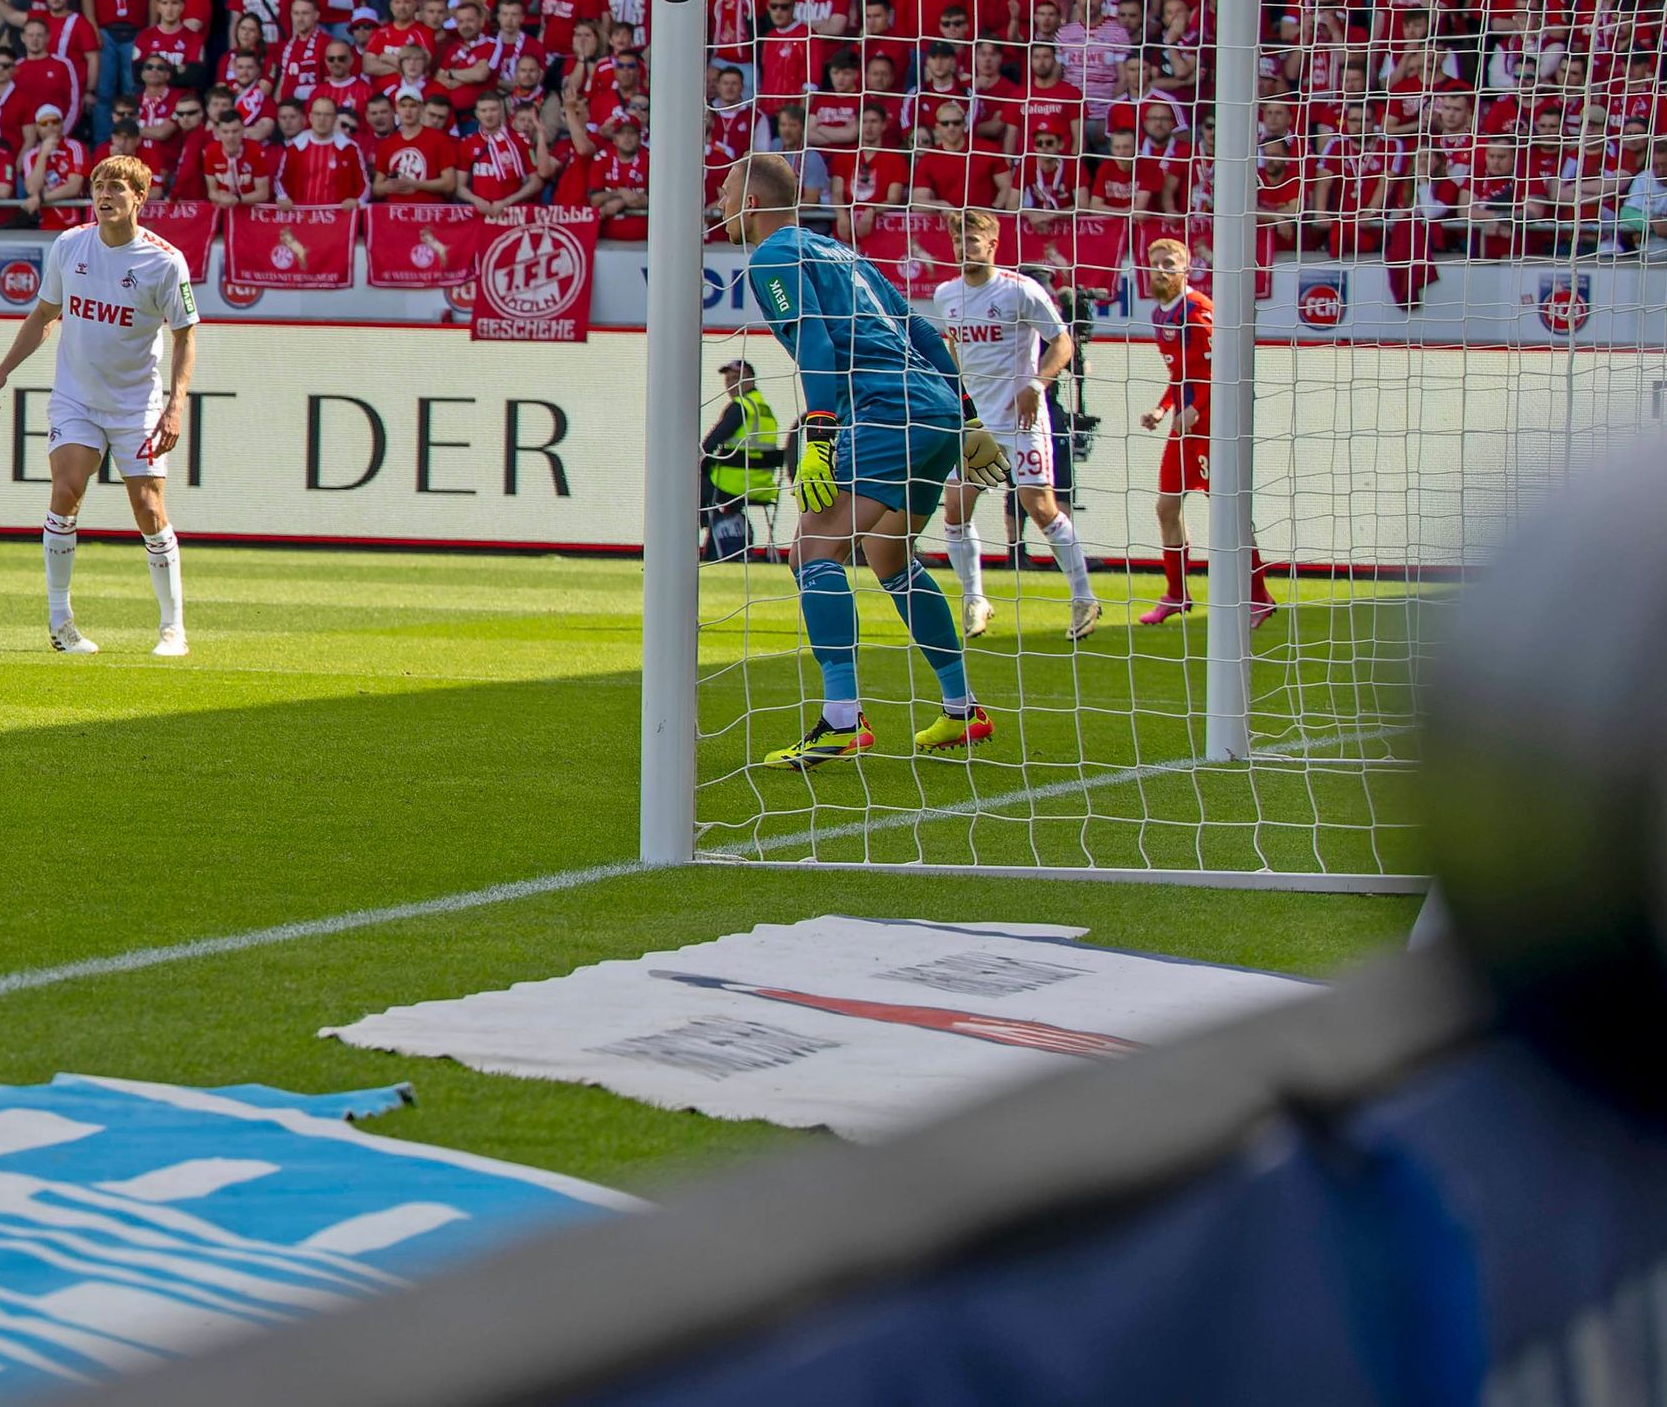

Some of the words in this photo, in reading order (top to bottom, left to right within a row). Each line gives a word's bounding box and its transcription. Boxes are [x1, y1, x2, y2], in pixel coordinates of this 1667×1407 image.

[171, 203, 198, 220] JAS
[249, 210, 269, 224] FC
[310, 210, 337, 226] JAS
[388, 206, 407, 221] FC
[446, 207, 474, 223] JAS
[69, 295, 135, 327] REWE
[180, 282, 195, 314] DEVK
[768, 279, 790, 314] DEVK
[853, 270, 899, 334] 1
[1305, 296, 1338, 317] FCH
[477, 319, 577, 341] GESCHEHE
[948, 325, 1004, 344] REWE
[135, 435, 155, 467] 4
[306, 393, 569, 499] DER
[1015, 448, 1044, 477] 29
